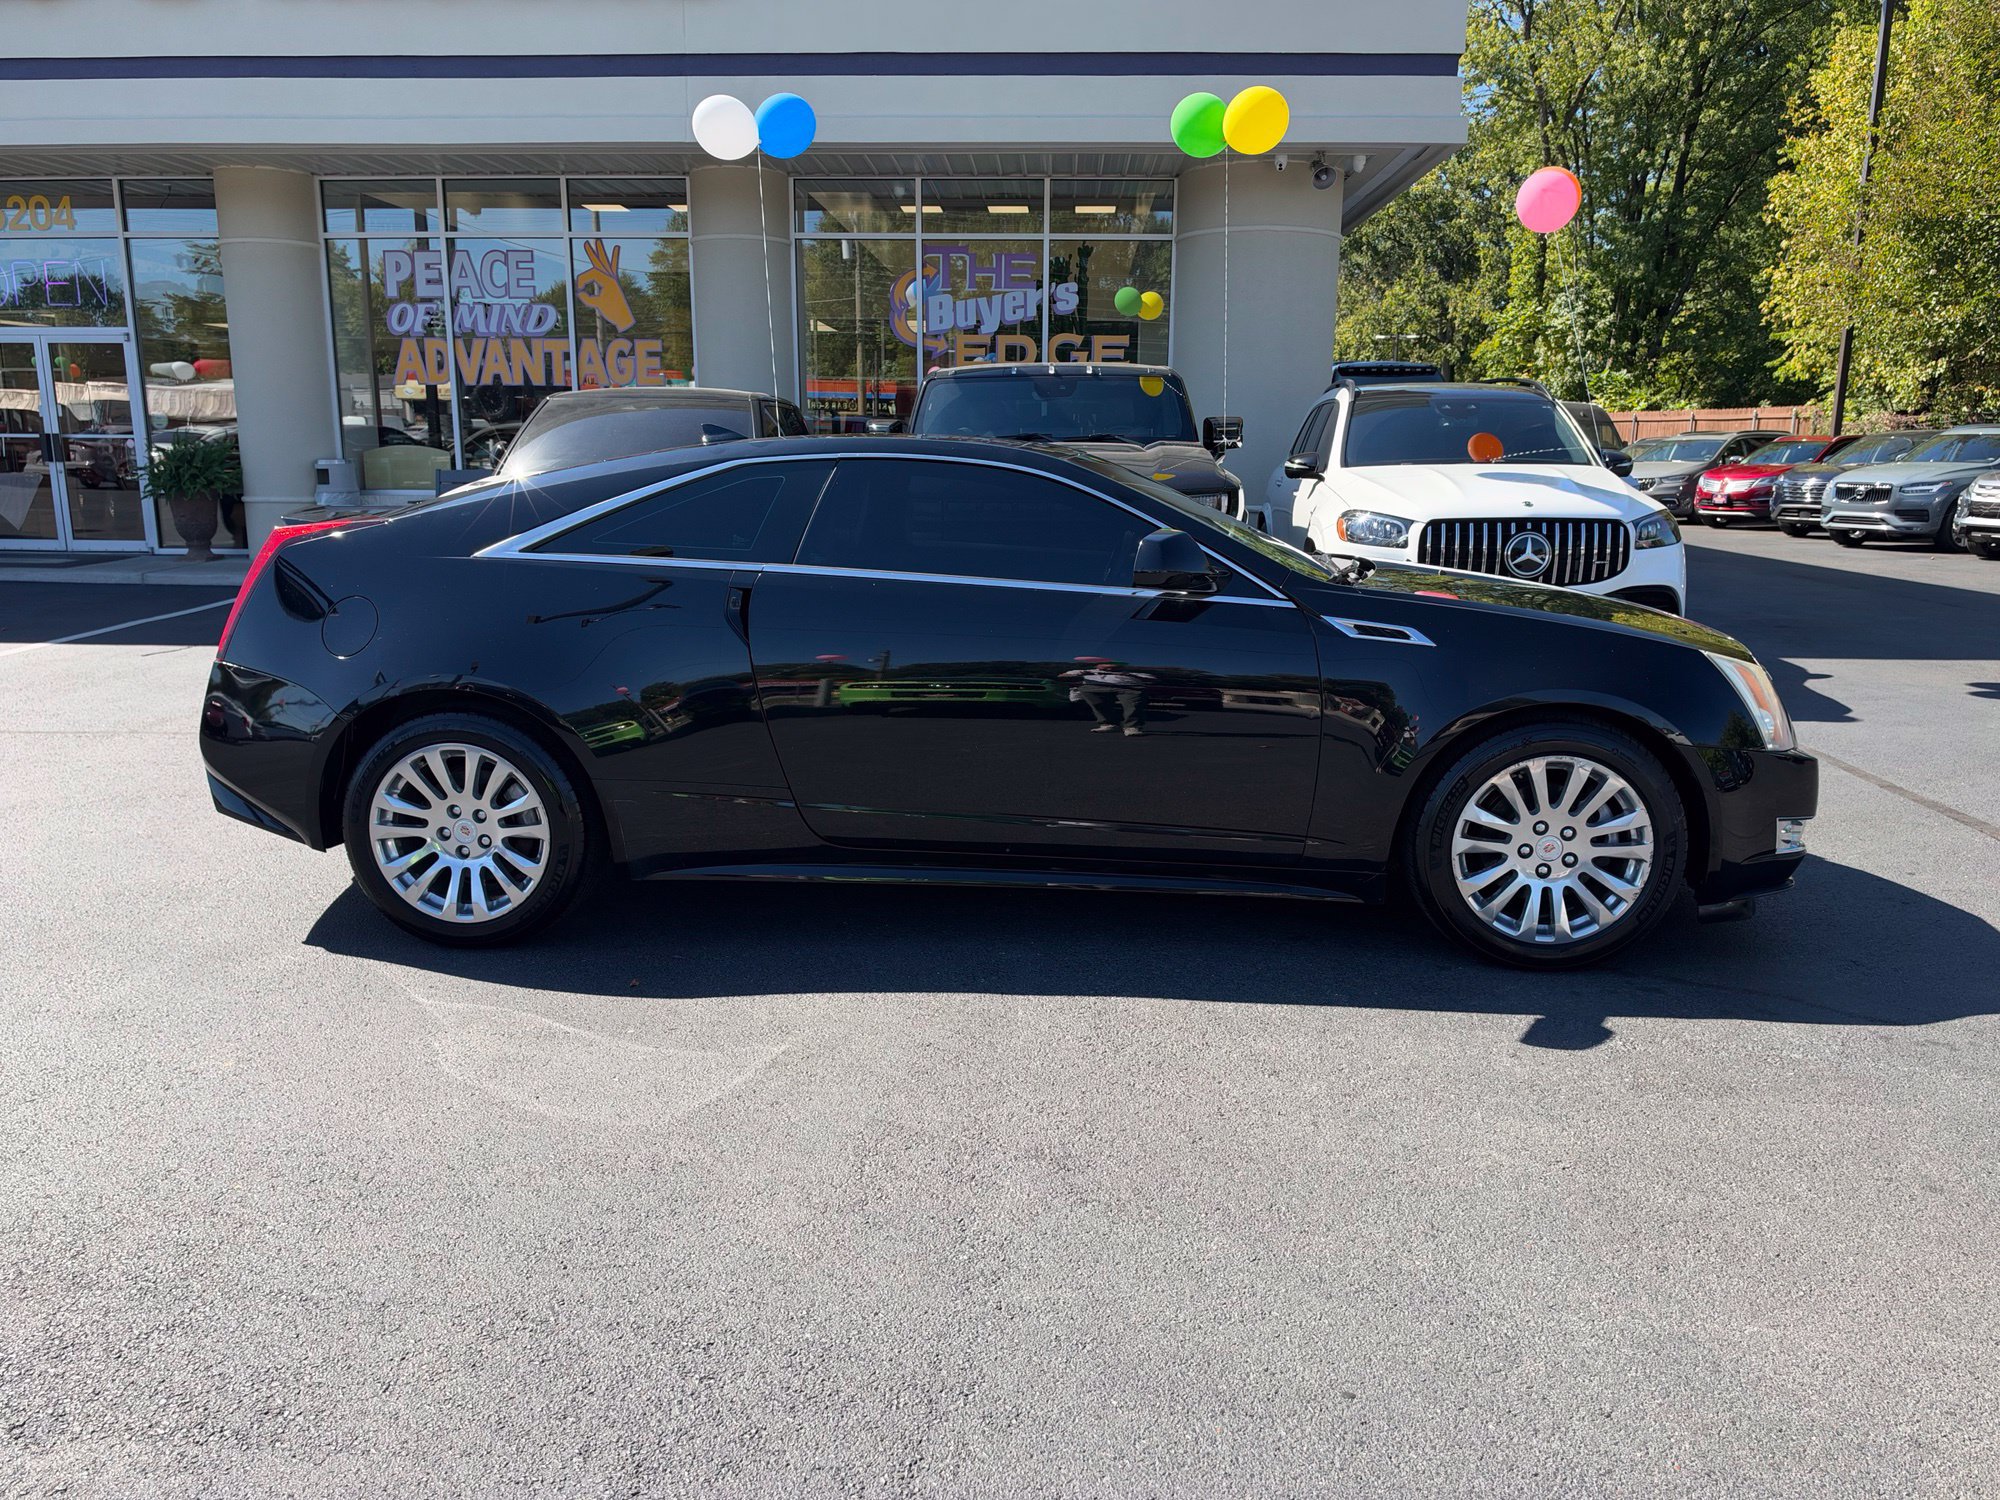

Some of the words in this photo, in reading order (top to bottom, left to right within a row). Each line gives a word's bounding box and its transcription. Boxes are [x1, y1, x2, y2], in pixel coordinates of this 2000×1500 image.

[382, 249, 537, 299] PEACE
[924, 244, 1038, 291] THE
[386, 301, 440, 337] OF
[453, 302, 558, 337] MIND
[926, 281, 1080, 335] Buyer's
[392, 337, 667, 387] ADVANTAGE
[954, 333, 1131, 364] EDGE
